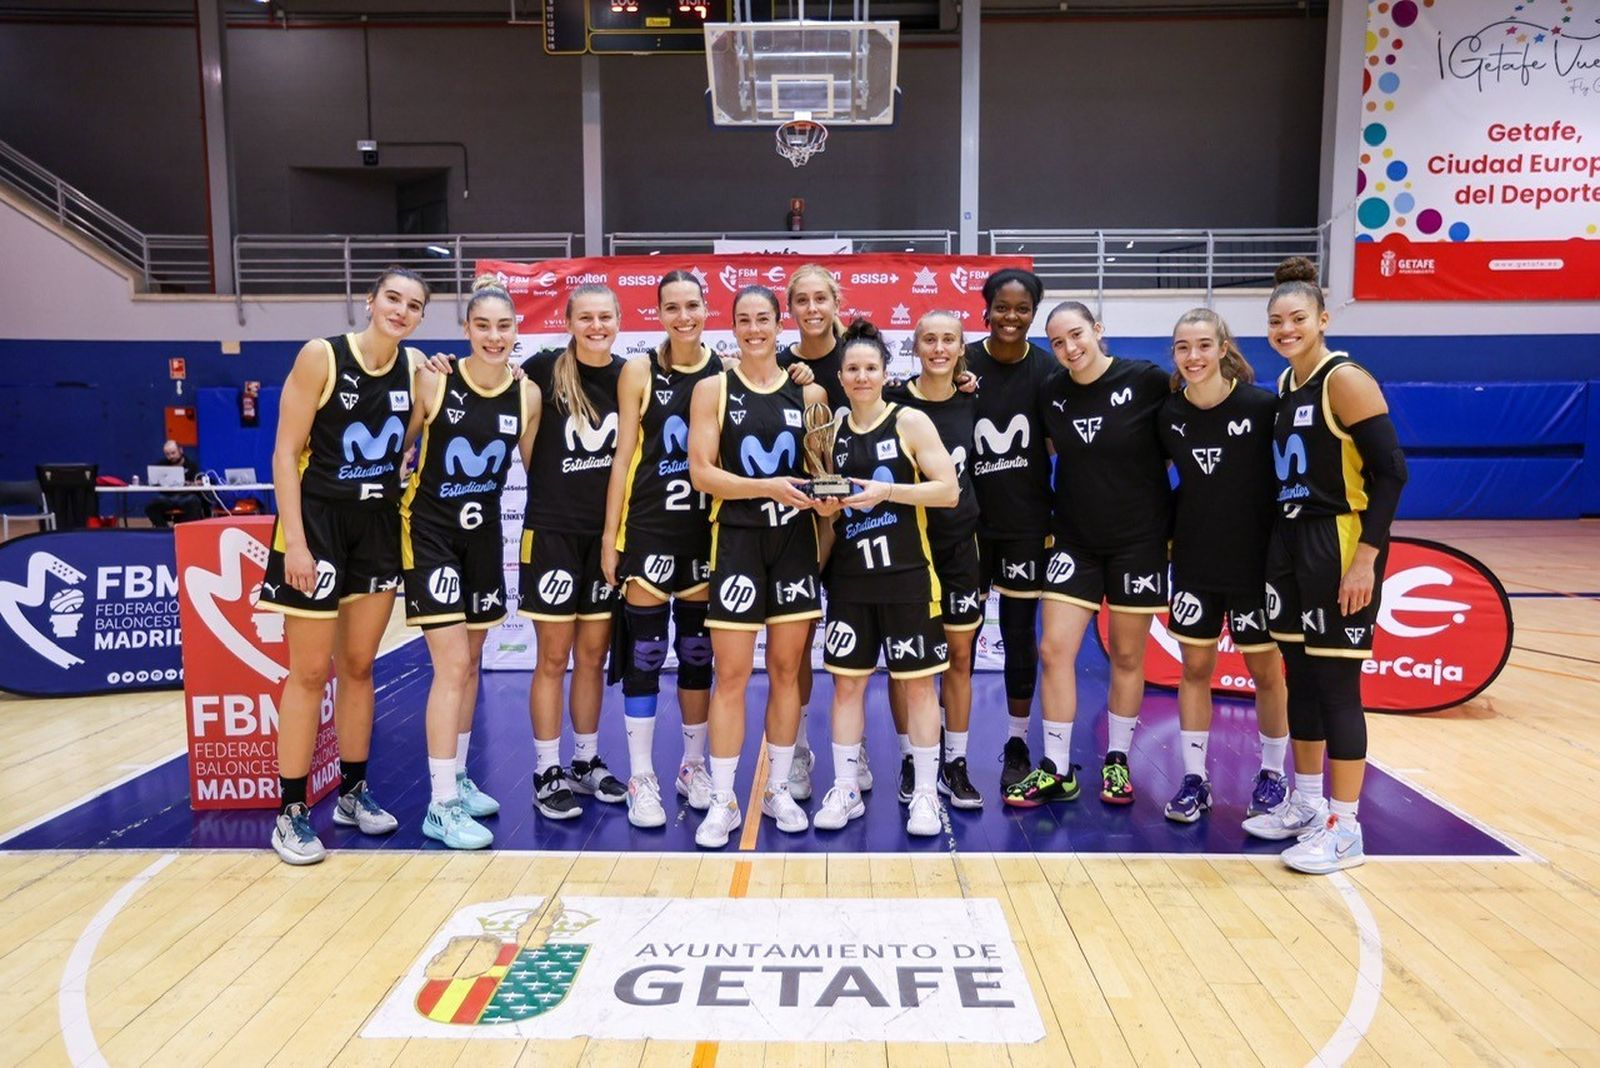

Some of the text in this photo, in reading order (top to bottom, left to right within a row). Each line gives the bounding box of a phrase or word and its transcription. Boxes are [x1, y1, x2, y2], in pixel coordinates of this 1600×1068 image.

[1487, 120, 1583, 144] Getafe,
[1427, 154, 1523, 174] Ciudad
[1455, 184, 1600, 210] del Deporte
[738, 268, 758, 278] FBM
[969, 270, 990, 280] FBM
[1398, 259, 1435, 269] GETAFE
[509, 275, 530, 284] FBM
[565, 273, 608, 285] molten
[974, 456, 1028, 475] Estudiantes
[459, 502, 483, 530] 6
[856, 535, 892, 569] 11
[648, 555, 672, 583] hp
[542, 570, 572, 605] hp
[724, 575, 753, 613] hp
[1174, 592, 1200, 625] hp
[828, 621, 854, 657] hp
[635, 943, 1001, 960] AYUNTAMIENTO DE
[613, 965, 1016, 1009] GETAFE
